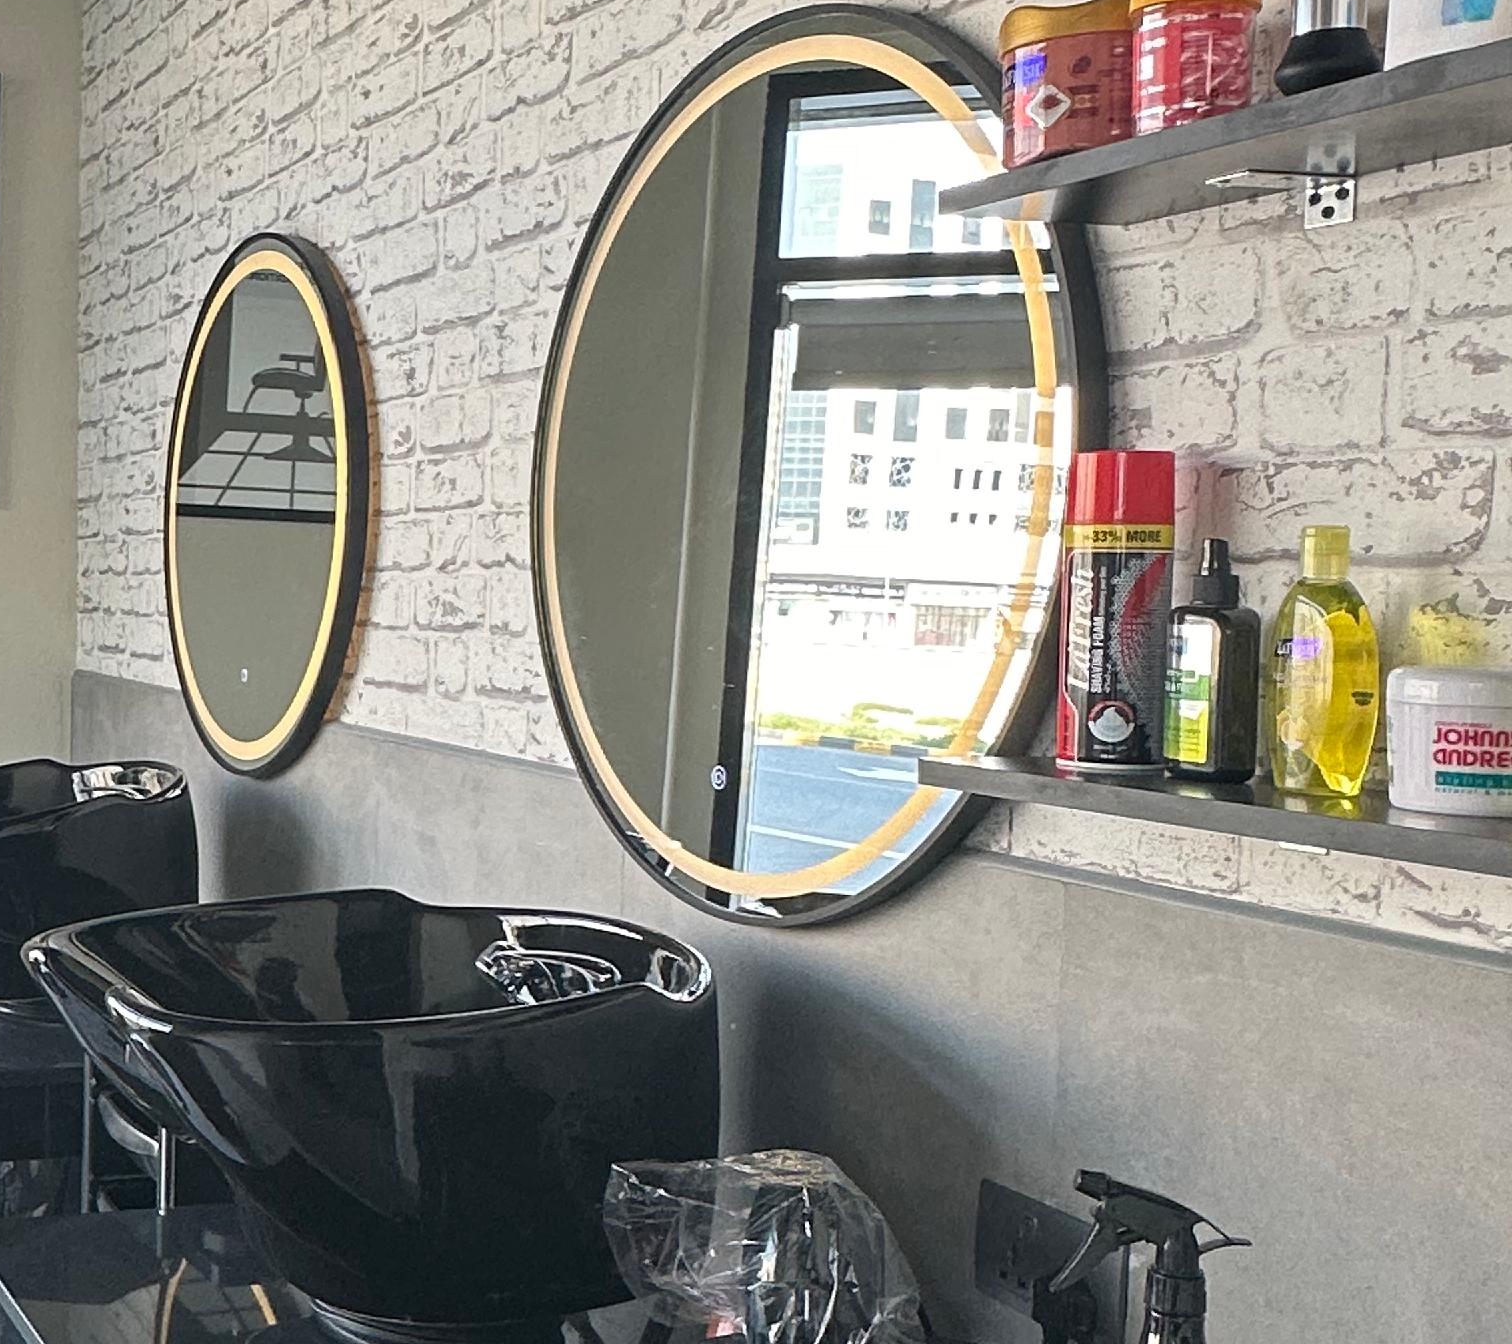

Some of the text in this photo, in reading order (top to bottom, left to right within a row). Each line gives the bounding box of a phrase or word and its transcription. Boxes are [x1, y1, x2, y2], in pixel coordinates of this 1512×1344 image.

[1126, 530, 1162, 544] MORE
[1092, 616, 1105, 646] FOAM
[1091, 649, 1104, 694] SHAVING
[1433, 727, 1512, 747] JOHNN
[1433, 748, 1512, 768] ANDRE
